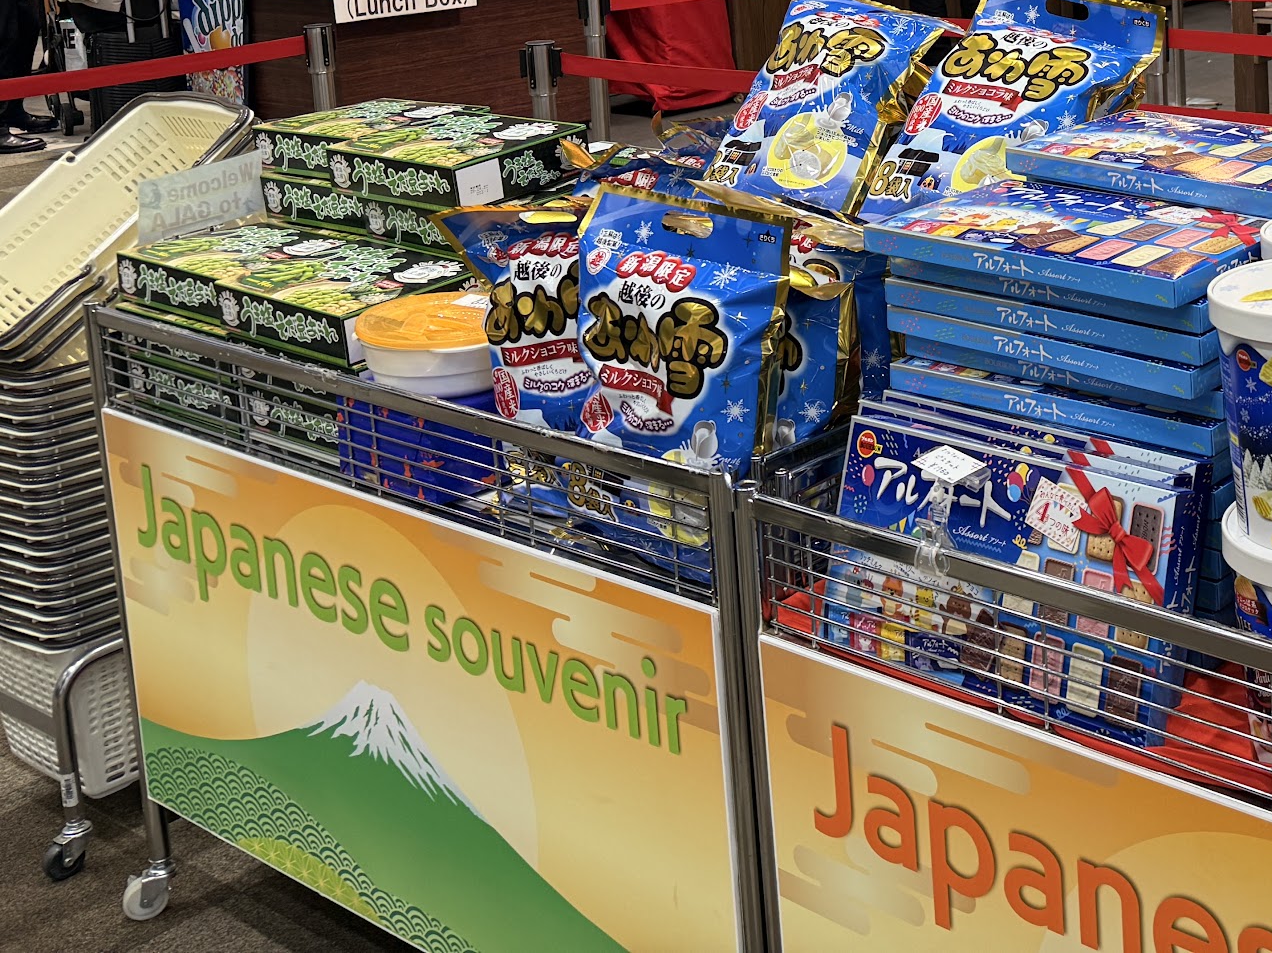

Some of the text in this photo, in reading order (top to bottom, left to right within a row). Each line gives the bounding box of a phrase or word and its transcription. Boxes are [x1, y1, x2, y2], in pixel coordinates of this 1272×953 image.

[942, 33, 1091, 102] あわ雪
[947, 81, 1013, 103] ミルクショコラ味
[1131, 115, 1247, 140] アルフォート
[871, 159, 910, 198] 8袋入
[1107, 171, 1195, 199] アルフォート Assort
[509, 233, 578, 255] 新潟限定
[514, 260, 562, 282] 越後の
[620, 253, 695, 292] 新潟限定
[1037, 266, 1067, 281] Assort
[503, 341, 578, 364] ミルクショコラ味
[137, 465, 688, 756] Japanese souvenir
